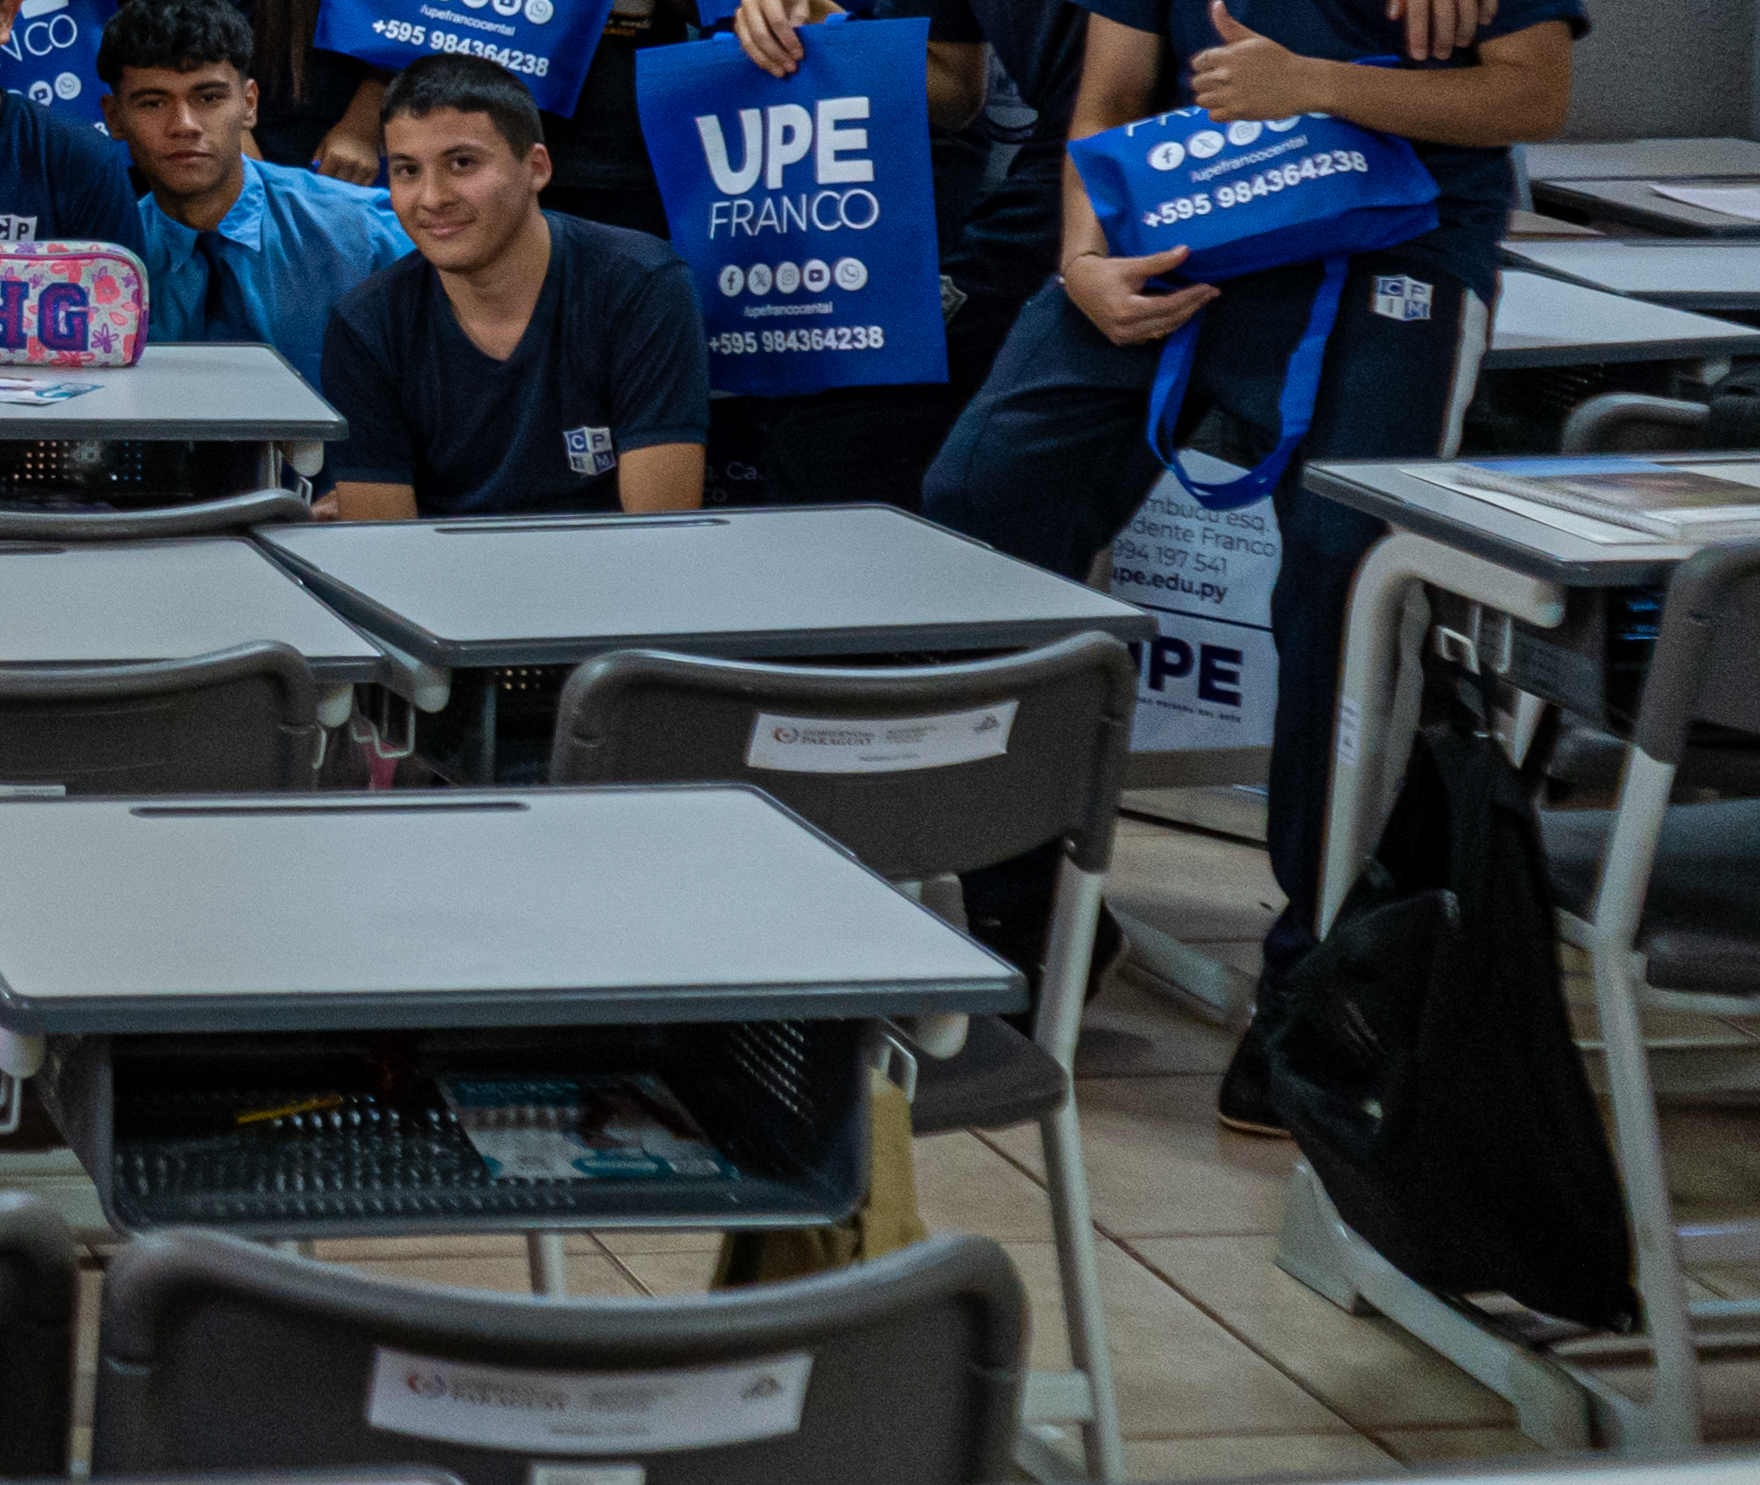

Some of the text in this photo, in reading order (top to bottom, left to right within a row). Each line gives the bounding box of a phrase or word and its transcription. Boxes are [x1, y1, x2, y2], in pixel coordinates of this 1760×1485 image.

[372, 19, 549, 77] +595 984364238
[694, 96, 874, 196] UPE
[708, 188, 880, 240] FRANCO
[1143, 150, 1368, 228] +595 984364238
[708, 325, 884, 354] +595 984364238
[1157, 546, 1188, 568] 197
[1194, 554, 1228, 575] 541
[1202, 527, 1276, 557] Franco
